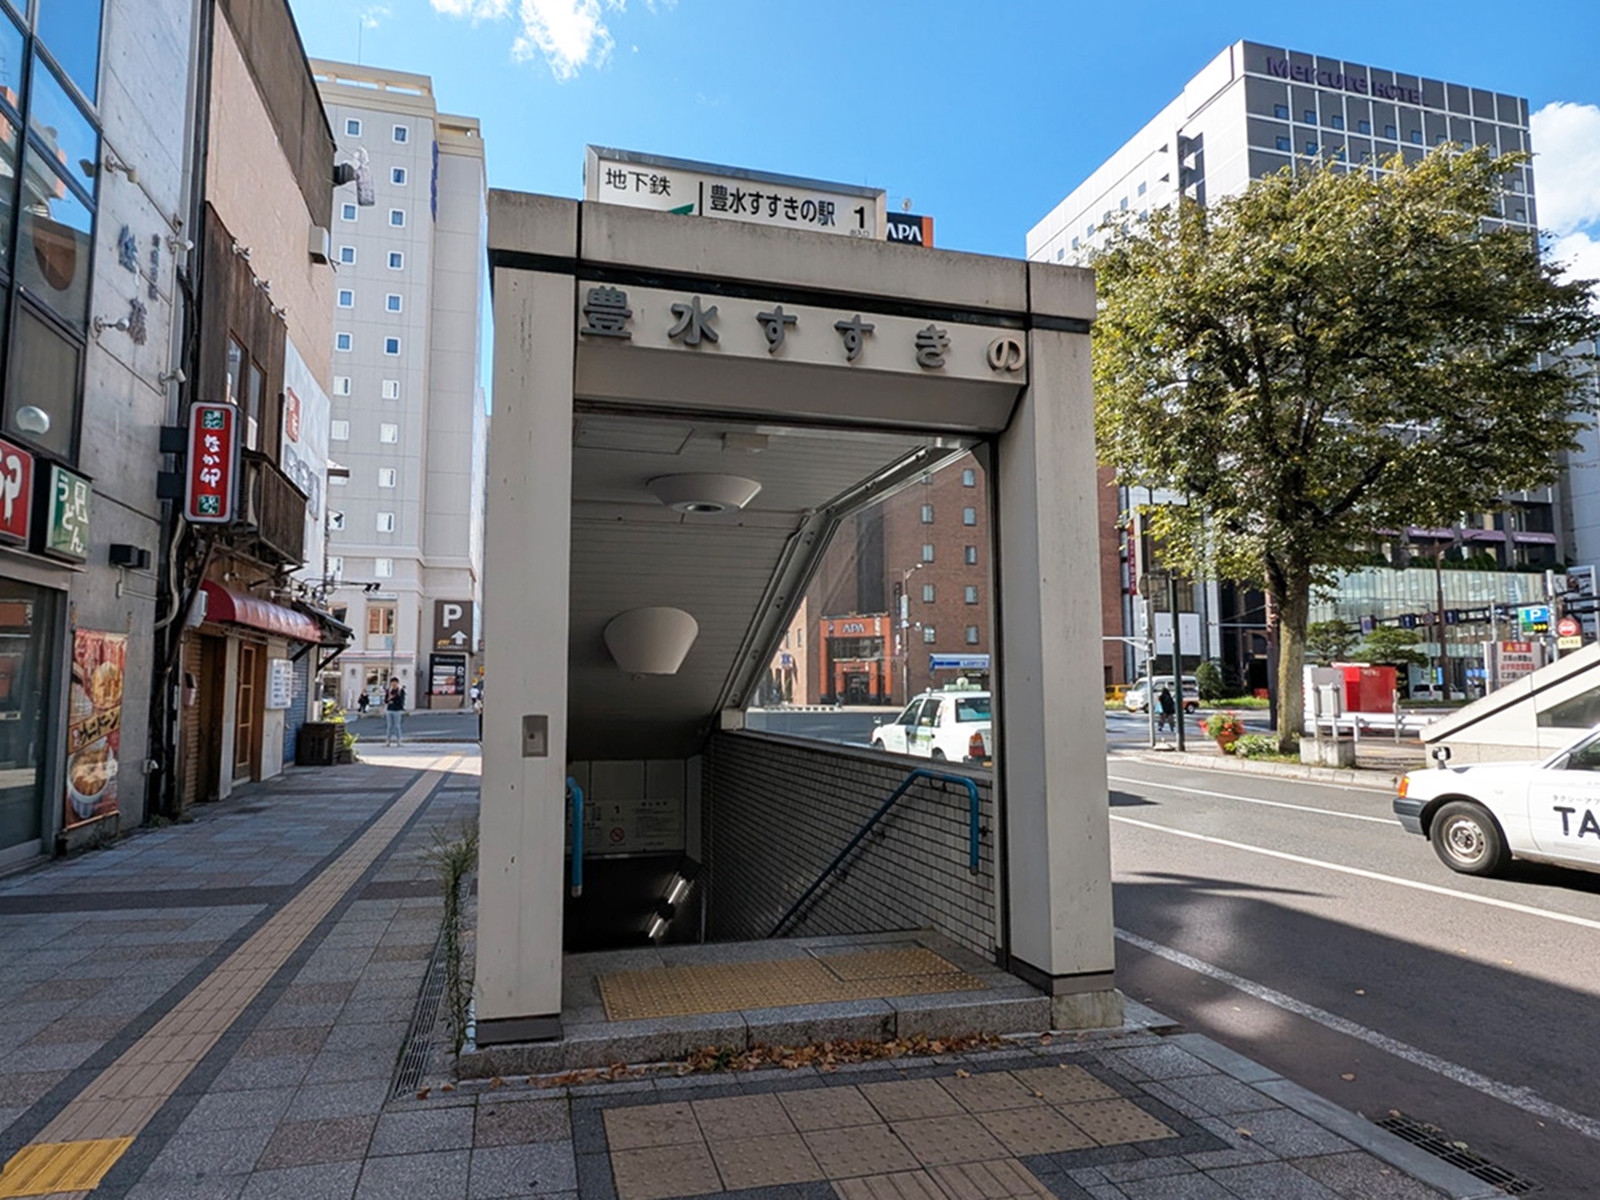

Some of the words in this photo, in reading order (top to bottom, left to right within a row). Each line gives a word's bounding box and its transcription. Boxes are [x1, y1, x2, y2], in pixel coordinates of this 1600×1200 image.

[605, 168, 671, 197] 地下鉄
[710, 184, 836, 227] 豊水すすきの駅
[854, 206, 864, 229] 1
[886, 222, 922, 242] APA
[580, 285, 1026, 372] 豊水すすきの
[200, 434, 221, 488] なか卯
[443, 604, 463, 628] P
[843, 623, 865, 633] APA
